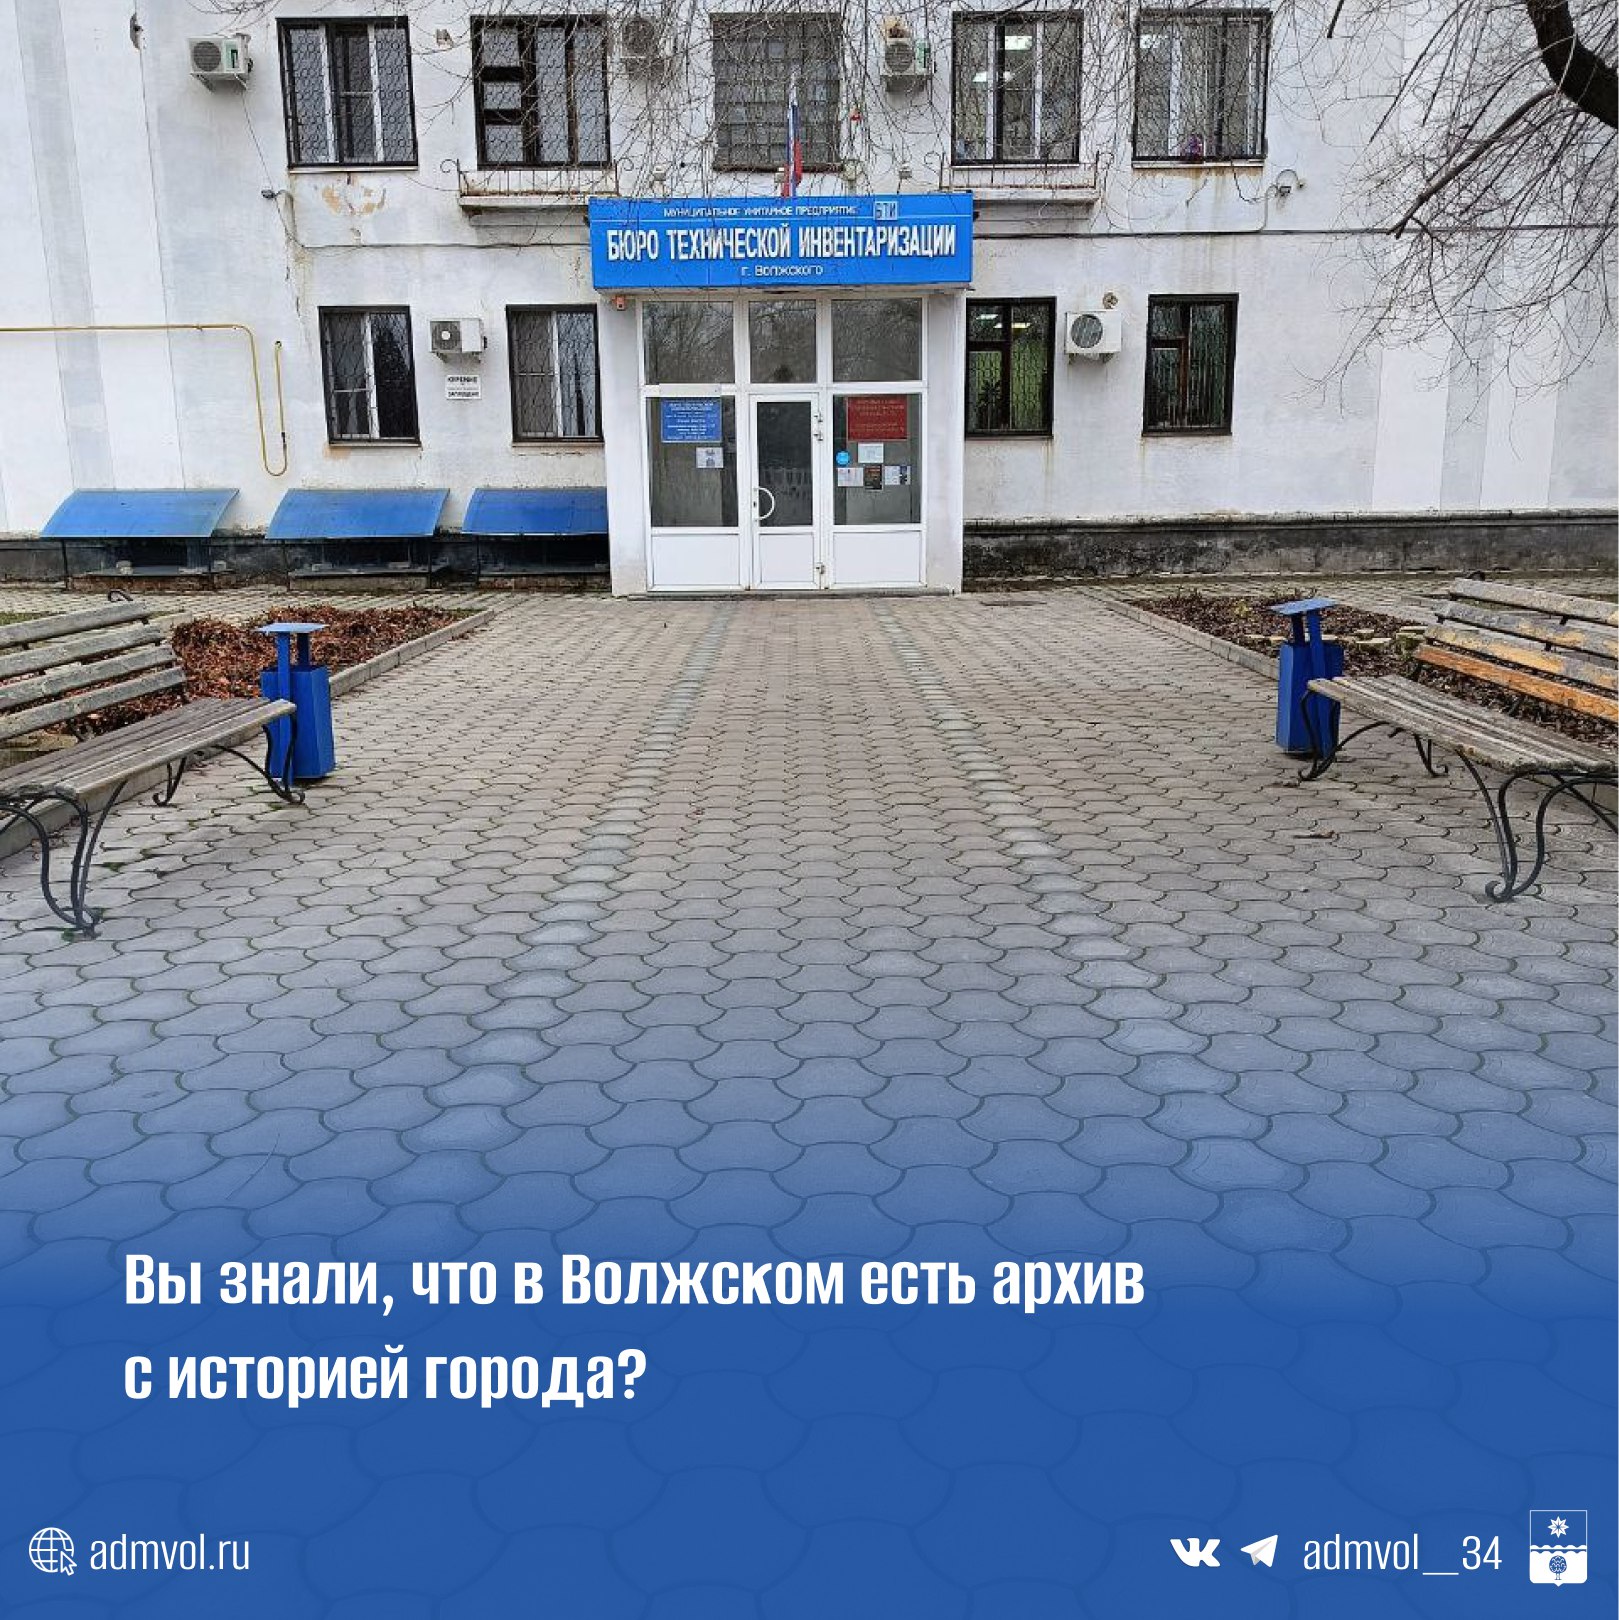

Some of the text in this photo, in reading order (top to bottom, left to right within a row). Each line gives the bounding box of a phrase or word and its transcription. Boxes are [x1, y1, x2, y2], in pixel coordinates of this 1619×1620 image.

[607, 223, 956, 261] БЮРО ТЕХНИЧЕСКОЙ ИНВЕНТАРИЗАЦИИ
[741, 264, 824, 277] г. Волжского
